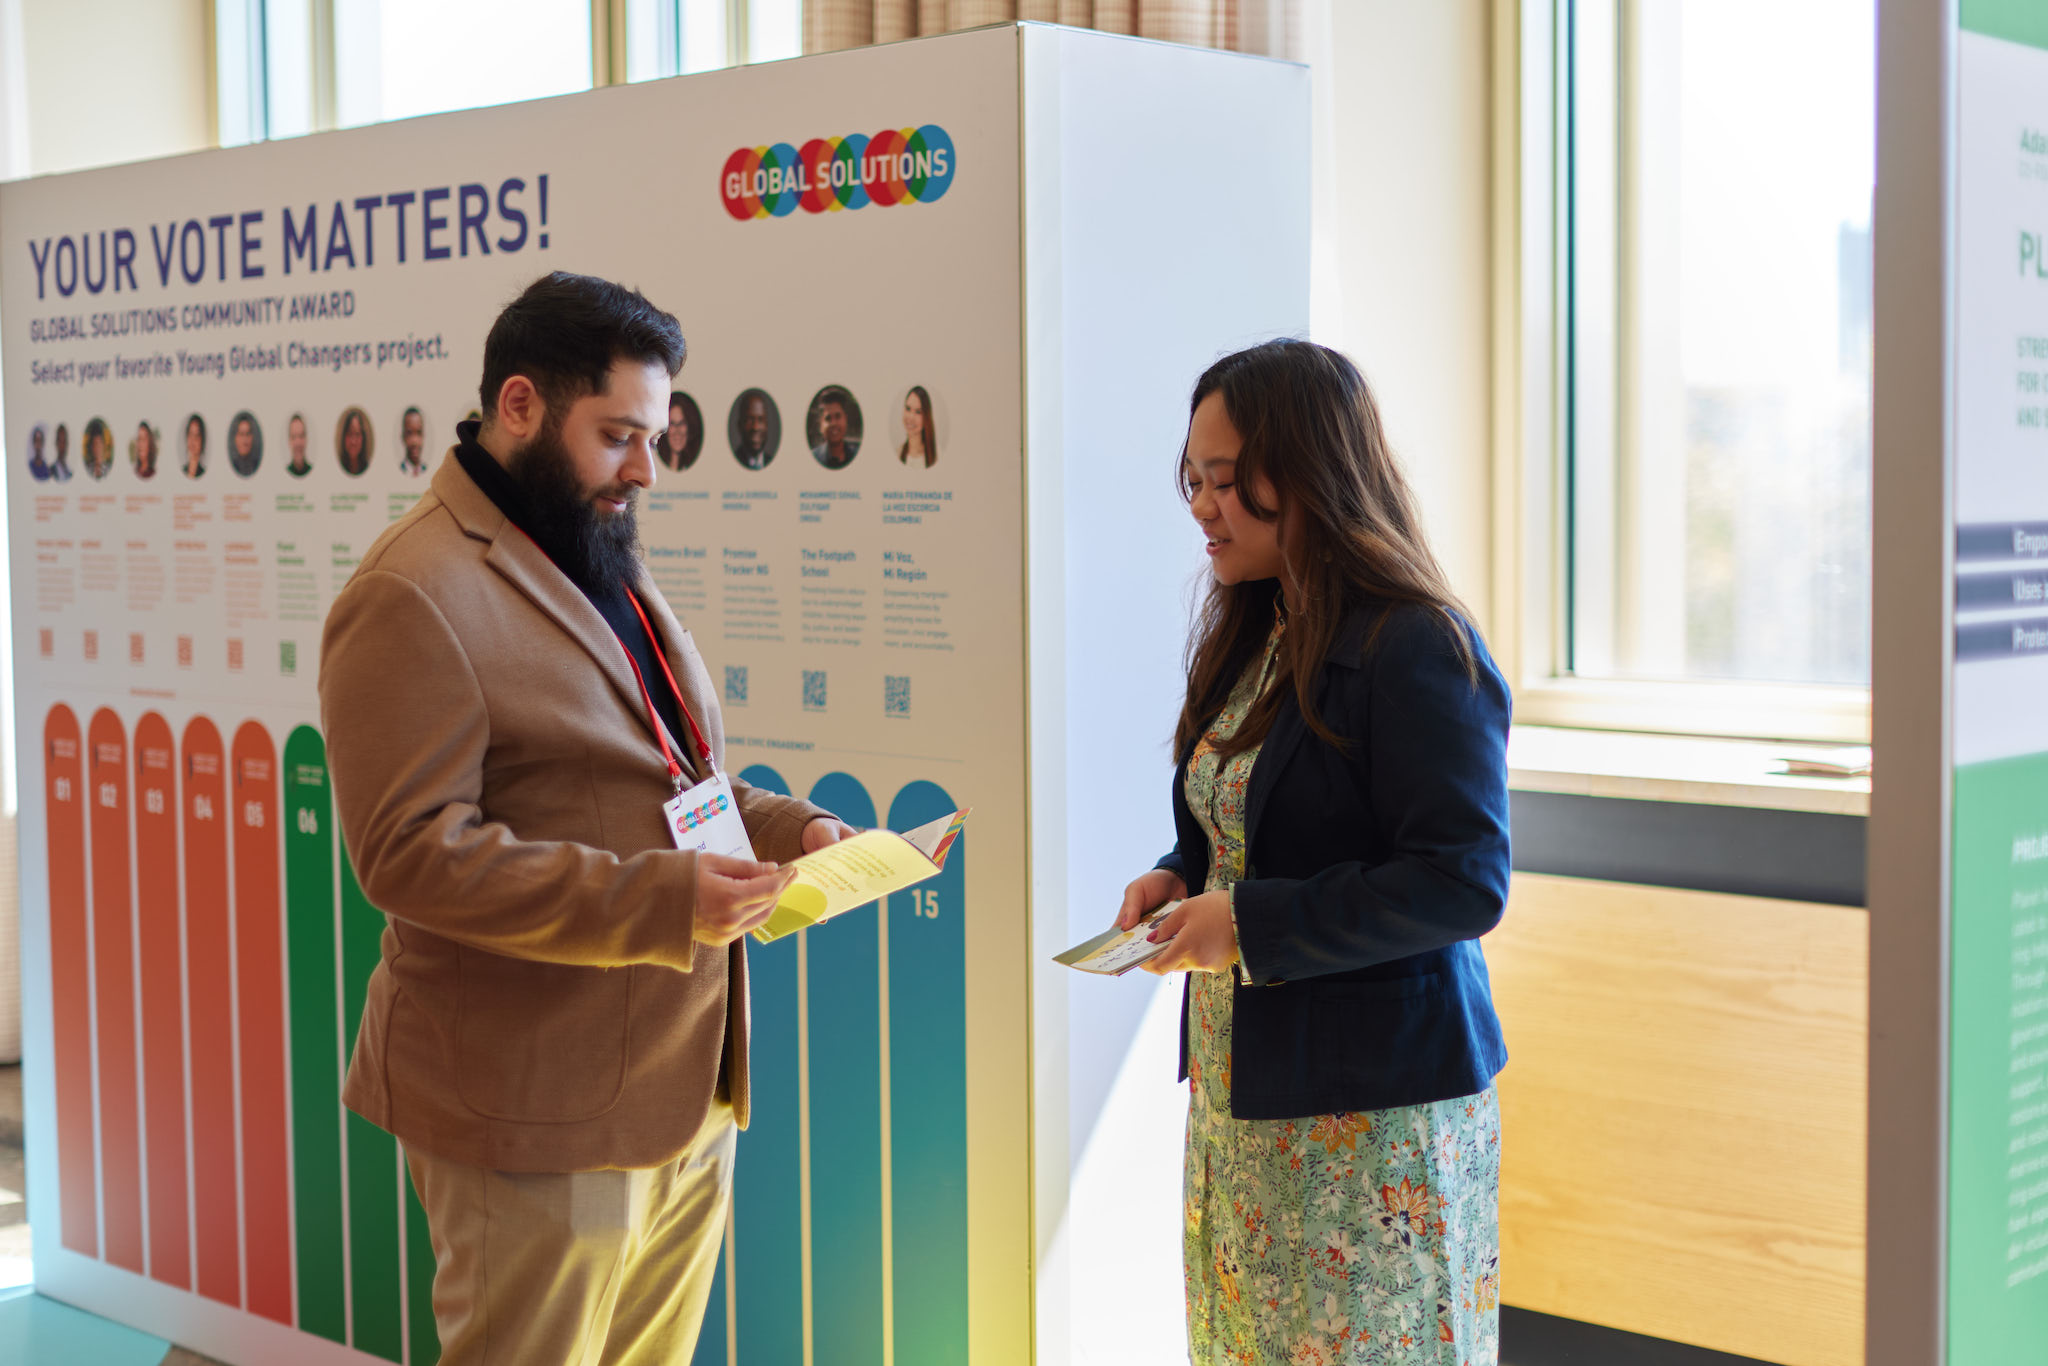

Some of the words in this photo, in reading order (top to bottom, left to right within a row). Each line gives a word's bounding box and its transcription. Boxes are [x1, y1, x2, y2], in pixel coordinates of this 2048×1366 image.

[725, 165, 812, 200] GLOBAL
[815, 148, 949, 190] SOLUTIONS
[28, 229, 138, 300] YOUR
[150, 211, 265, 288] VOTE
[282, 174, 549, 275] MATTERS!
[30, 316, 87, 343] GLOBAL
[90, 304, 178, 338] SOLUTIONS
[181, 296, 285, 331] COMMUNITY
[288, 289, 356, 322] AWARD
[30, 359, 75, 385] Select
[78, 359, 111, 388] your
[114, 352, 174, 380] favorite
[176, 348, 226, 380] Young
[229, 343, 283, 373] Global
[287, 340, 372, 373] Changers
[376, 332, 449, 370] project.
[905, 490, 942, 501] FERNANDA
[943, 491, 953, 502] DE
[722, 547, 757, 559] Promise
[801, 549, 817, 561] The
[818, 550, 856, 564] Footpath
[884, 551, 895, 563] Mi
[896, 551, 915, 565] Voz,
[723, 563, 754, 576] Tracker
[756, 565, 769, 575] NG
[801, 566, 829, 578] School
[884, 568, 895, 580] Mi
[896, 568, 927, 583] Región
[766, 739, 815, 752] ENGAGEMENT
[55, 777, 71, 801] 01
[100, 783, 118, 808] 02
[194, 794, 213, 820] 04
[245, 800, 264, 828] 05
[678, 813, 700, 832] GLOBAL
[698, 797, 729, 819] SOLUTIONS
[298, 808, 318, 835] 06
[911, 888, 940, 919] 15
